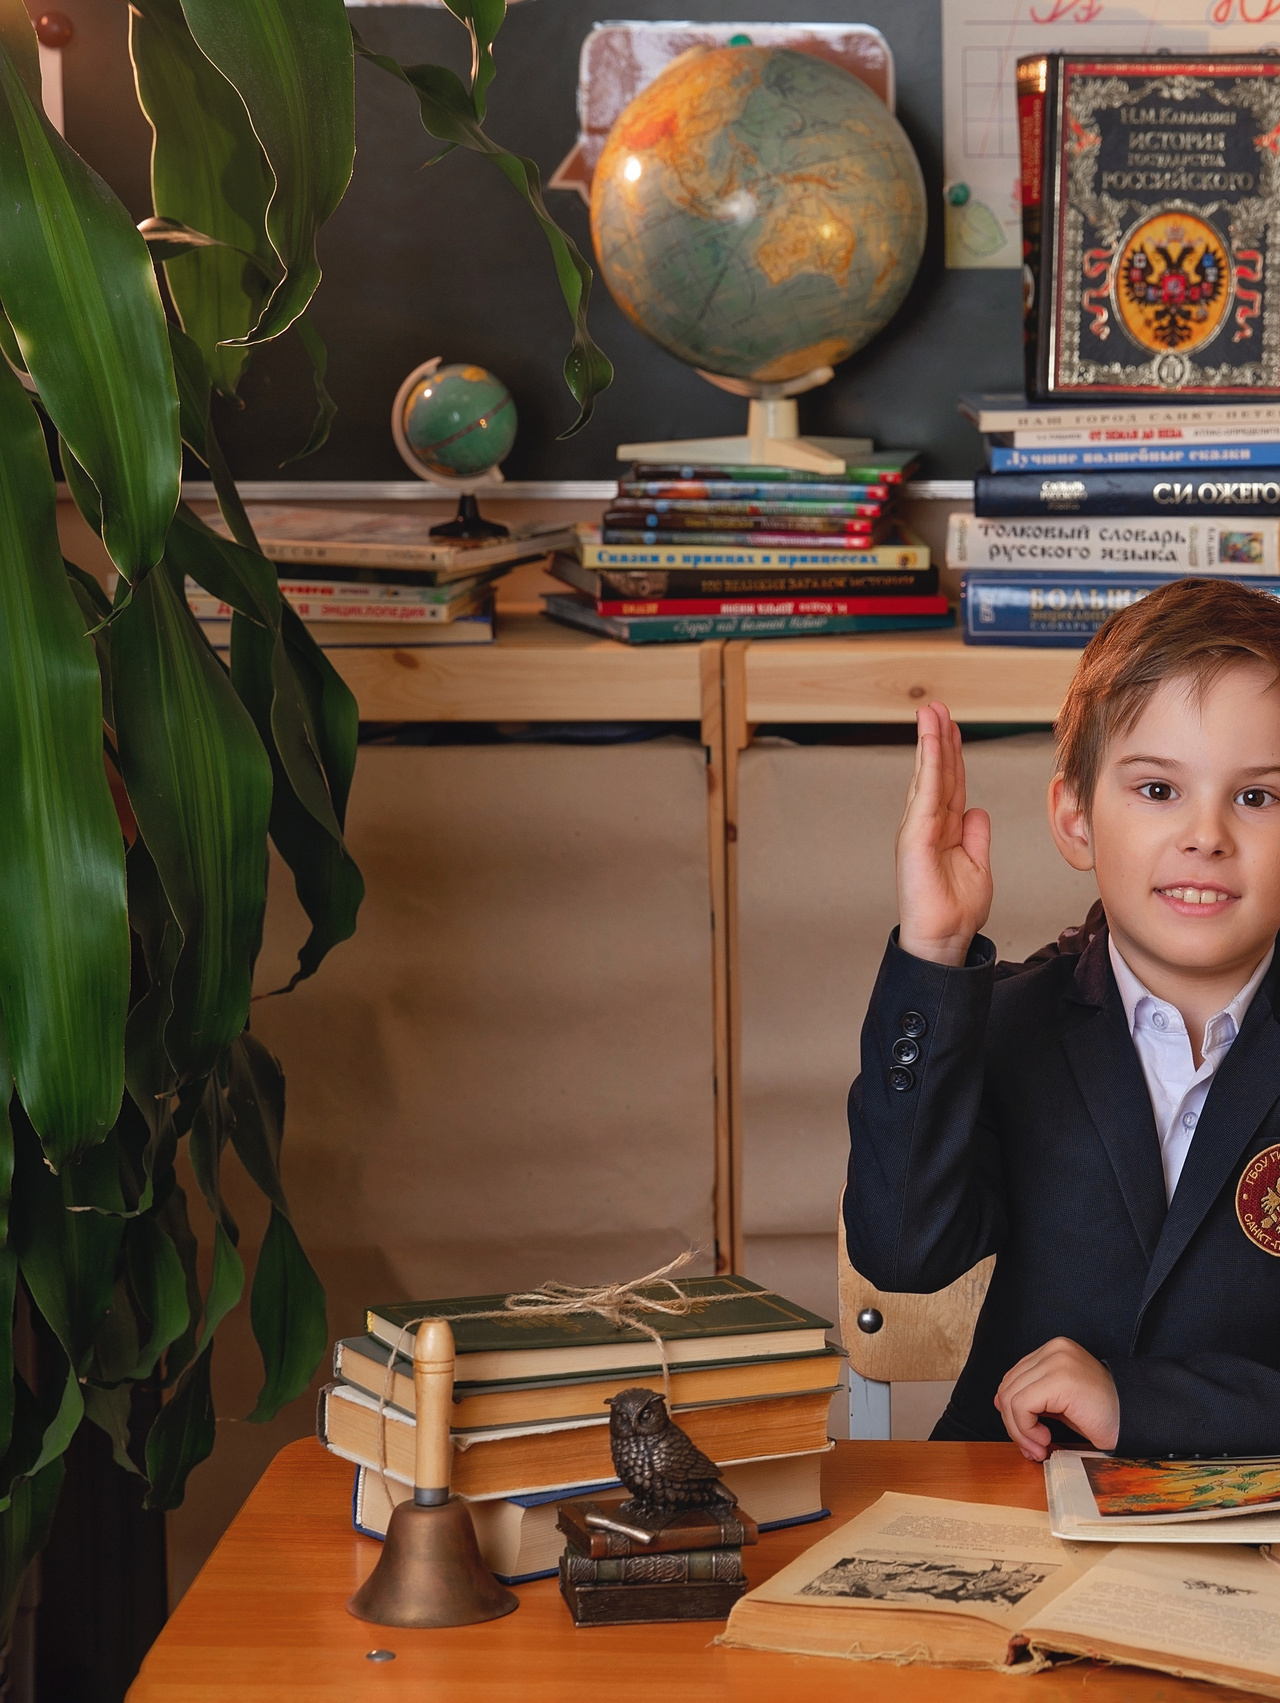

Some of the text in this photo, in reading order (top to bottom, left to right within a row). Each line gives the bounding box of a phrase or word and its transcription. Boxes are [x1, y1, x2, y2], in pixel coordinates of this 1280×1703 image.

[1128, 131, 1226, 151] ИСТОРИЯ
[1101, 166, 1254, 191] РОССИЙСКОГО
[1018, 416, 1062, 426] НАШ
[1075, 413, 1137, 425] ГОРОД
[1006, 447, 1251, 469] Лучшие волшебные сказки
[597, 551, 879, 568] Сказки о принцах и принцессах
[320, 603, 426, 619] ЭНЦИКЛОПЕДИЯ
[1245, 1156, 1268, 1185] ГБОУ
